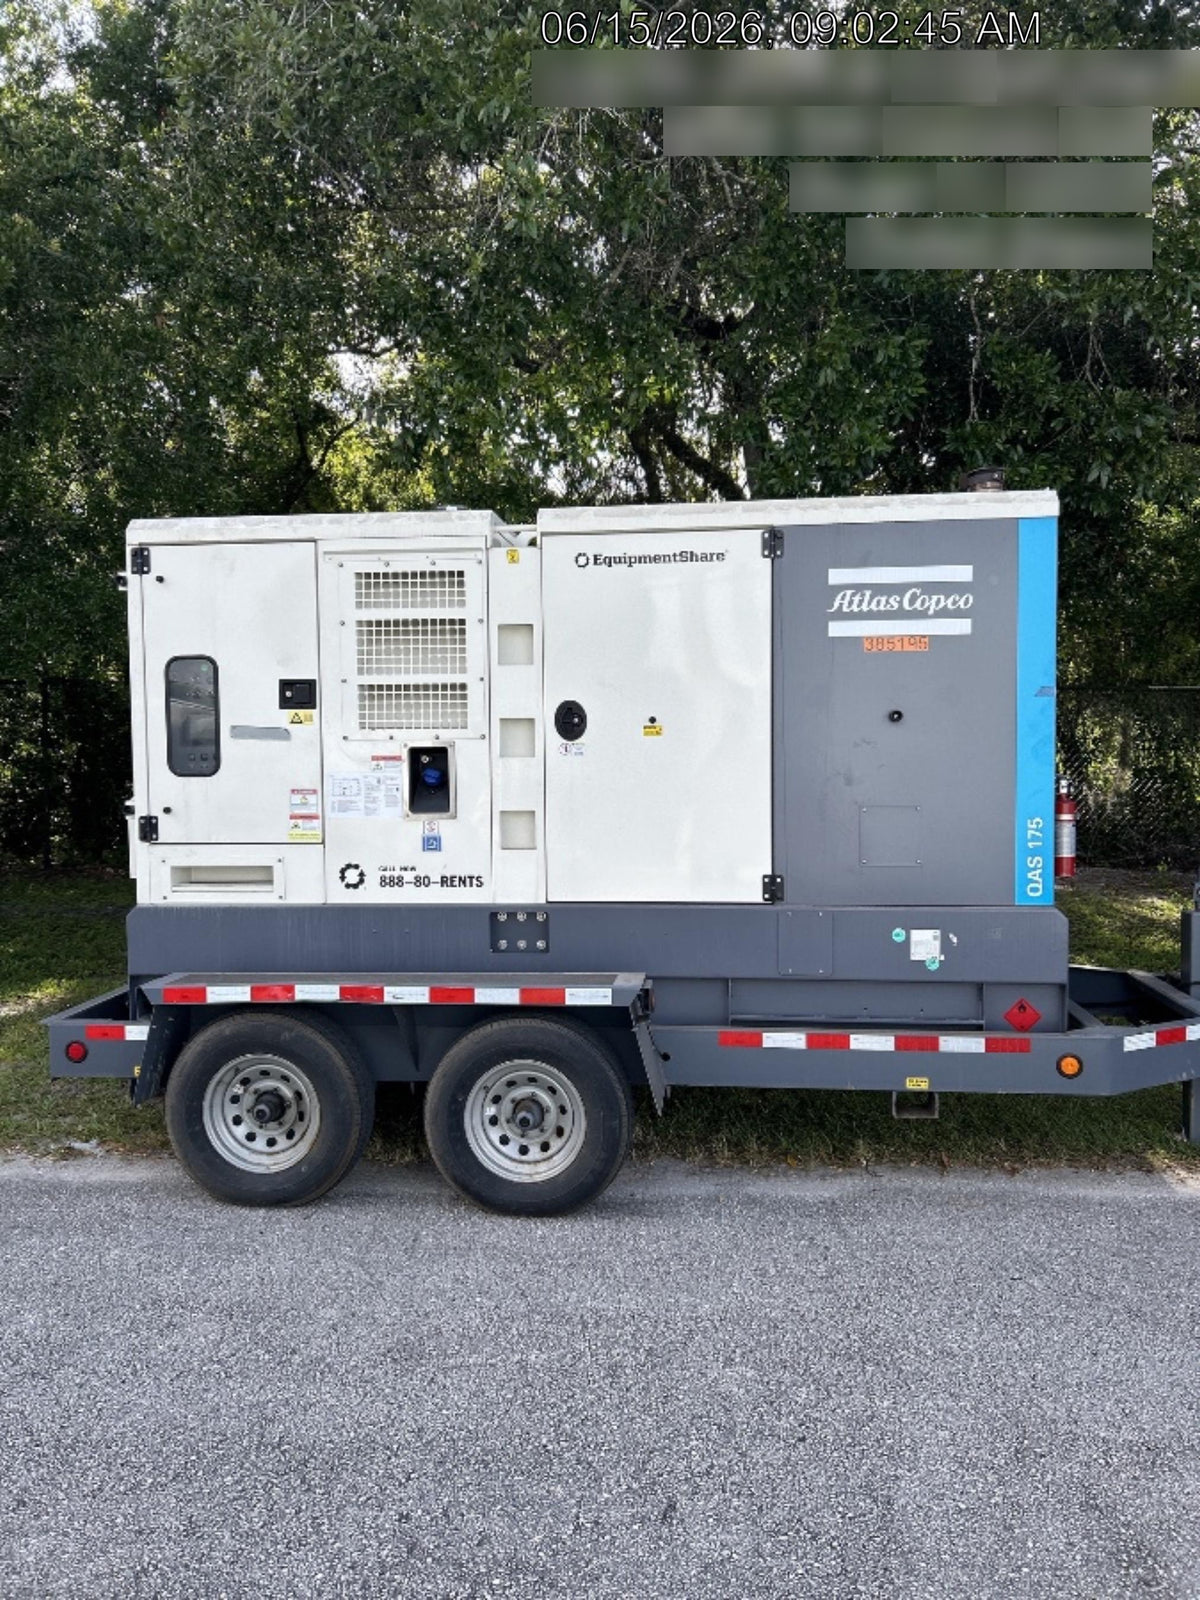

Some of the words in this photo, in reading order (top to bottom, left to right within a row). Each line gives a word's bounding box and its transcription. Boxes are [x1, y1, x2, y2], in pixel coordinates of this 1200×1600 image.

[593, 550, 725, 567] EquipmentShare
[826, 589, 900, 613] Atlas
[902, 588, 974, 615] Copco
[1027, 817, 1043, 849] 175
[379, 874, 484, 888] 888-80-RENTS
[1027, 855, 1043, 897] QAS
